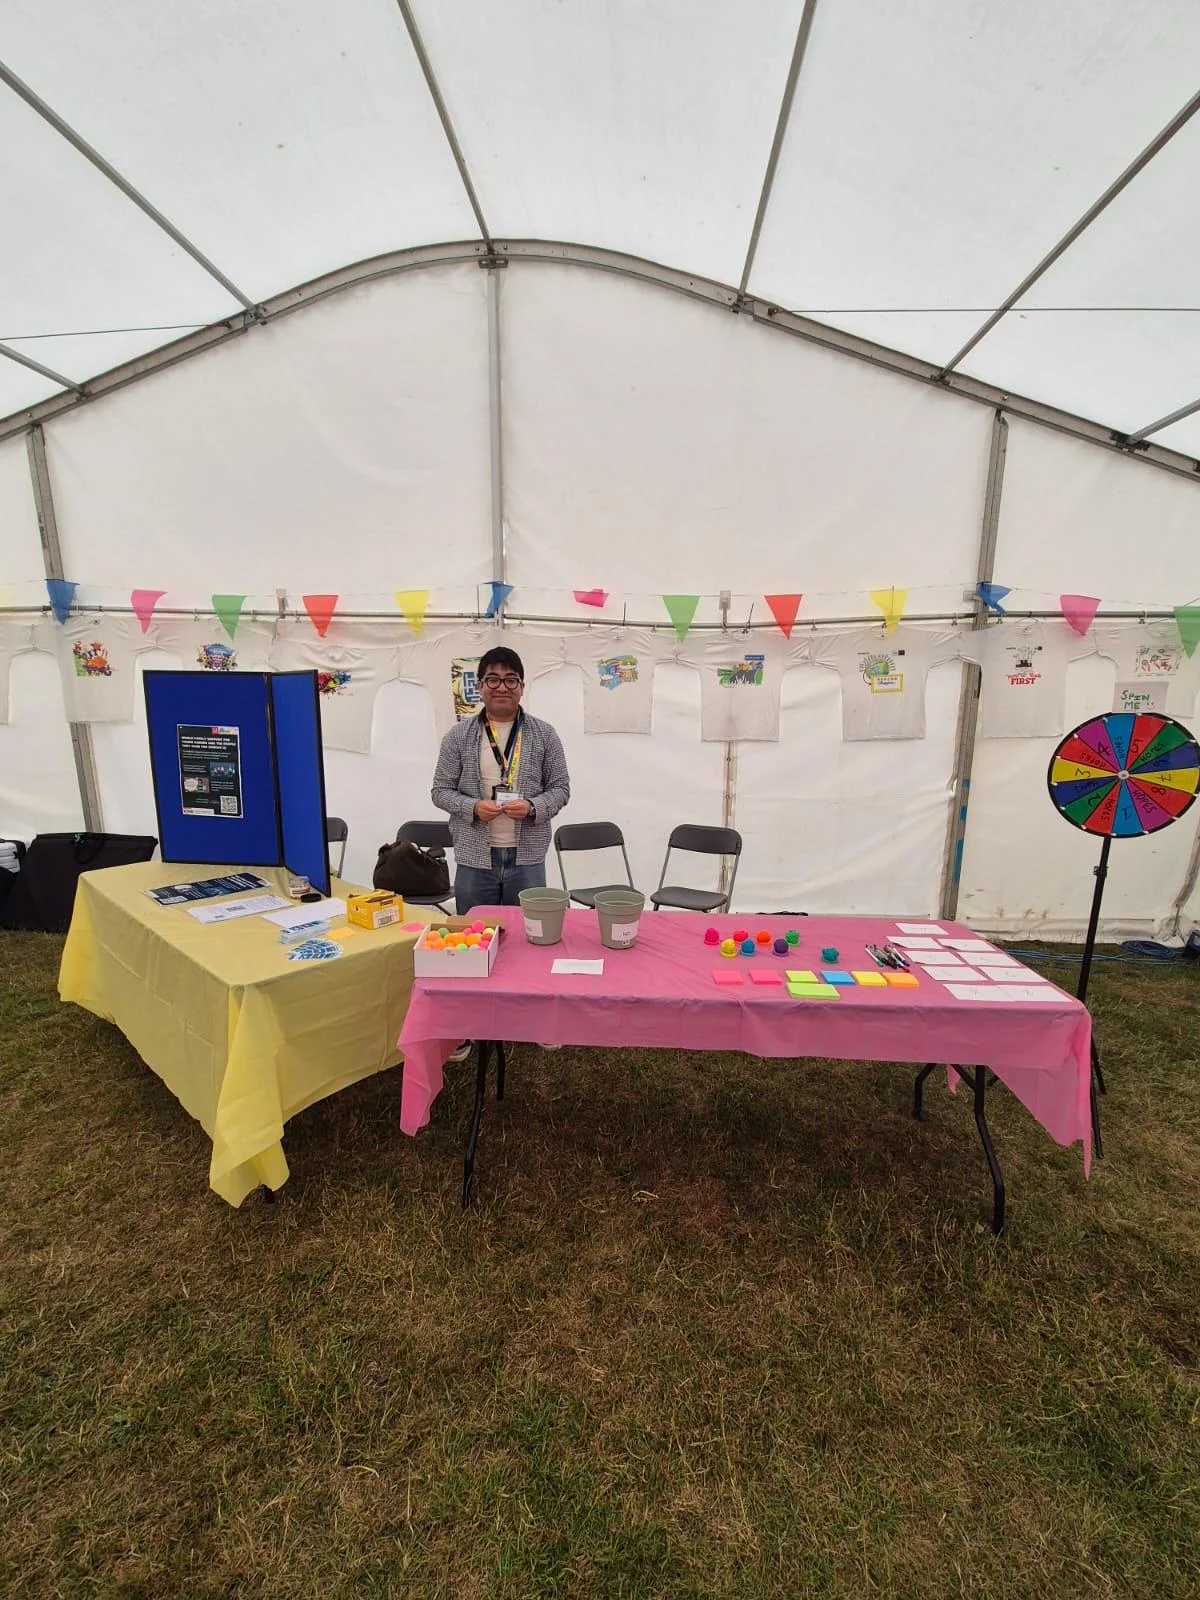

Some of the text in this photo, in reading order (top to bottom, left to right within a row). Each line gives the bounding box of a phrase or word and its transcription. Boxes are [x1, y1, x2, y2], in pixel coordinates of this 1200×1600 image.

[1120, 689, 1151, 701] SPIN
[1124, 702, 1141, 710] ME
[1098, 742, 1110, 756] 4
[1130, 739, 1144, 753] 5
[1075, 768, 1091, 777] 3
[1151, 786, 1167, 795] 8
[1088, 793, 1101, 806] 2
[1132, 790, 1158, 813] HOPES
